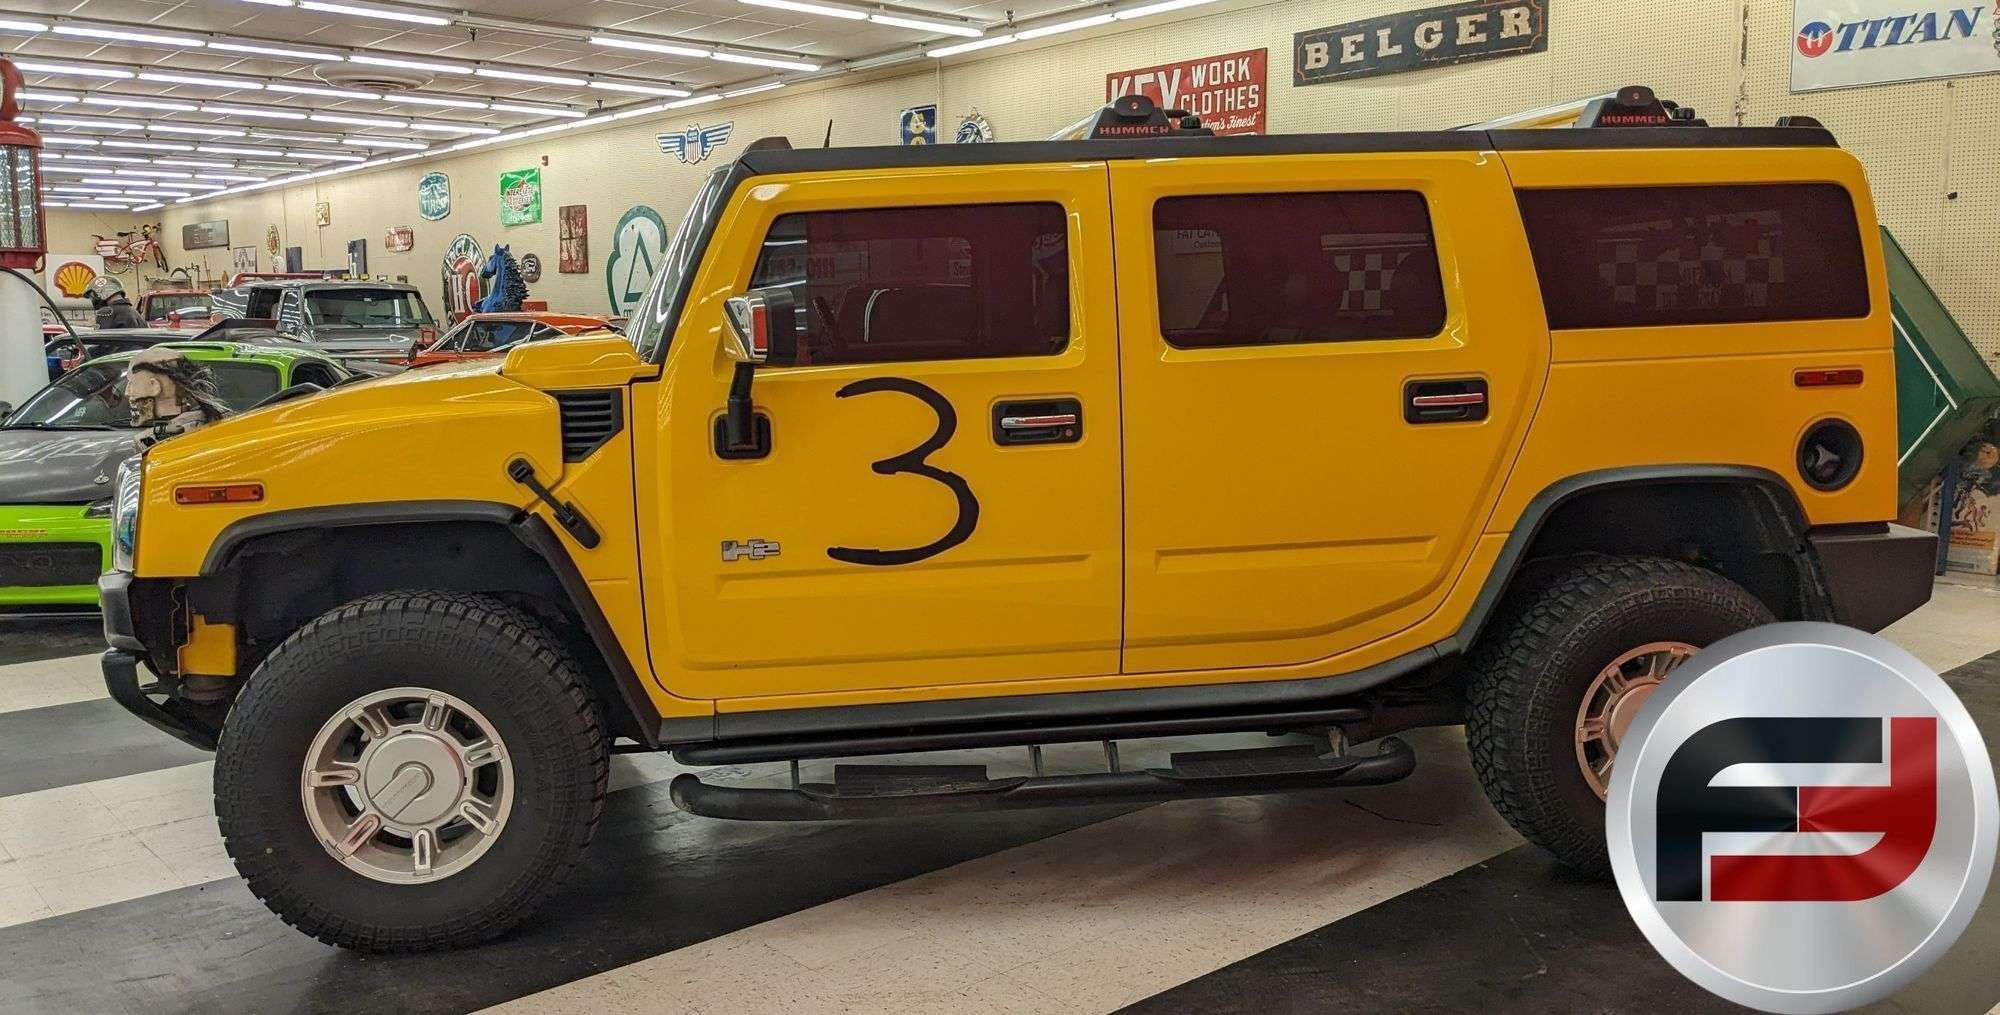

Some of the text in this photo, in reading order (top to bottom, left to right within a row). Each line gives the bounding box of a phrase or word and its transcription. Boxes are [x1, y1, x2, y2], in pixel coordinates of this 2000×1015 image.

[1304, 6, 1532, 70] BELGER
[1834, 6, 1985, 54] TITAN
[1191, 56, 1251, 89] WORK
[1180, 84, 1260, 117] CLOTHES
[1099, 125, 1169, 135] HUMMER
[1600, 115, 1666, 125] HUMMER
[826, 376, 981, 566] 3
[721, 538, 781, 561] H2
